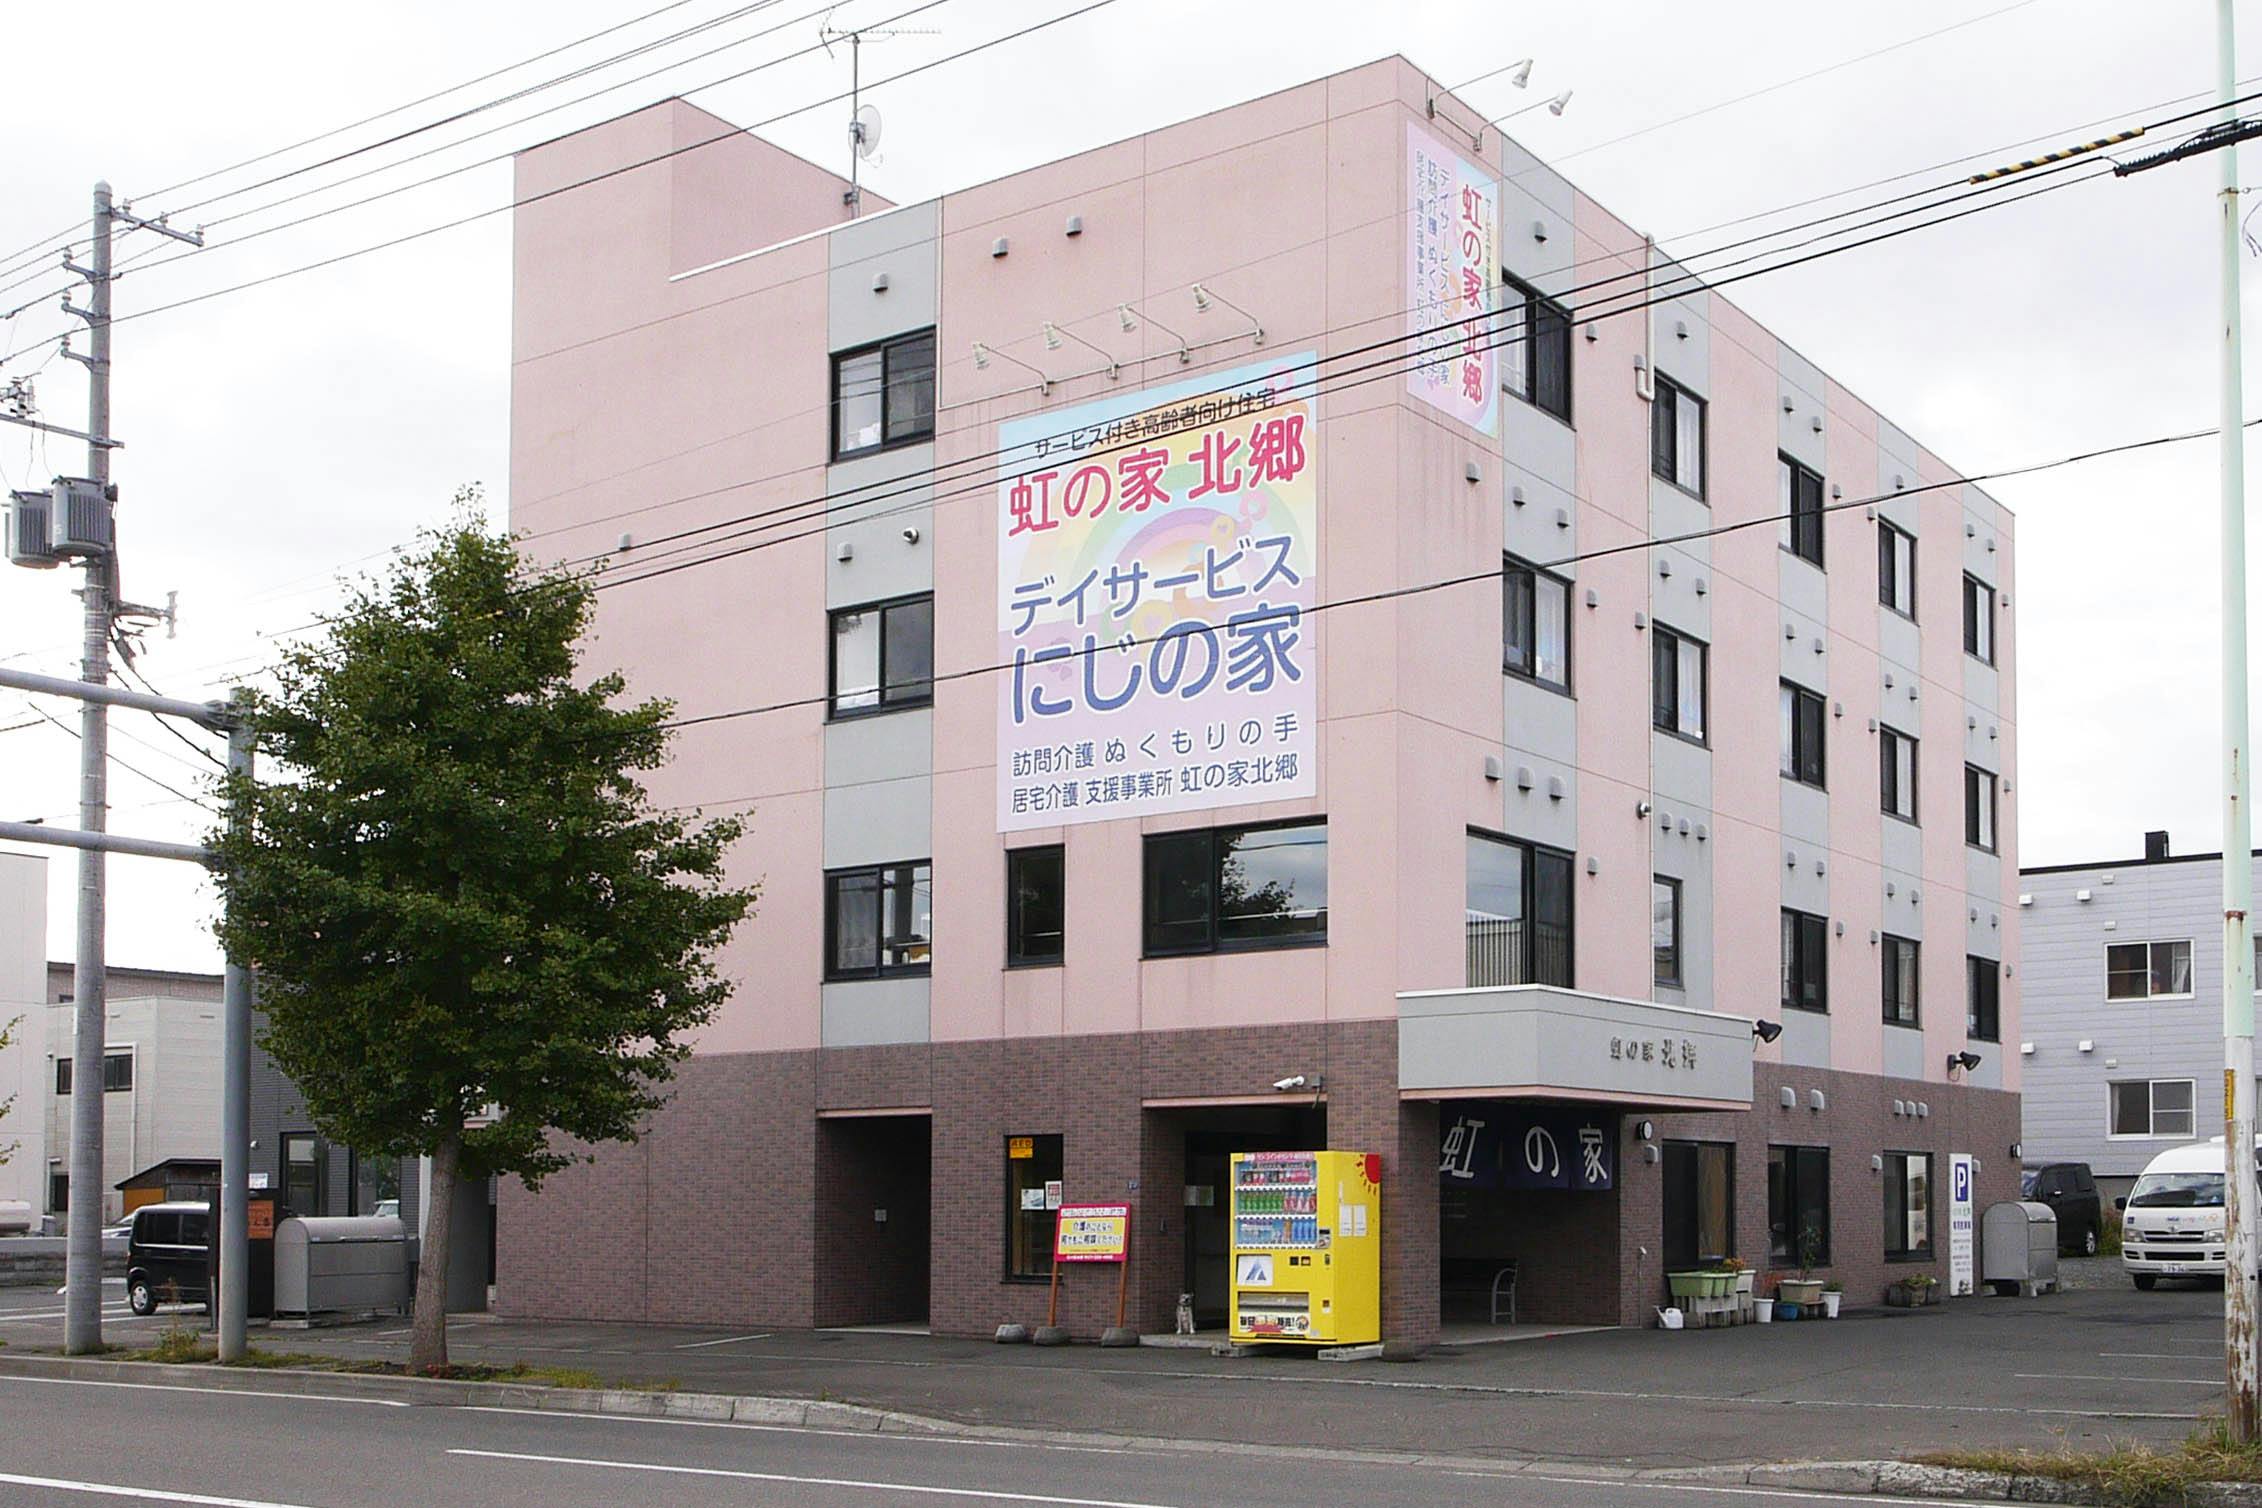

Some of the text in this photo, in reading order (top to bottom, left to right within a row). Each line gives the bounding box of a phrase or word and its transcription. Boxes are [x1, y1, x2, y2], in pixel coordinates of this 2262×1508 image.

[1034, 387, 1277, 459] サービス付き高齢者向け住宅
[1010, 535, 1301, 636] デイサービス
[1013, 602, 1302, 725] にじの家
[1439, 1113, 1608, 1184] 虹の家
[1956, 1165, 1967, 1199] P
